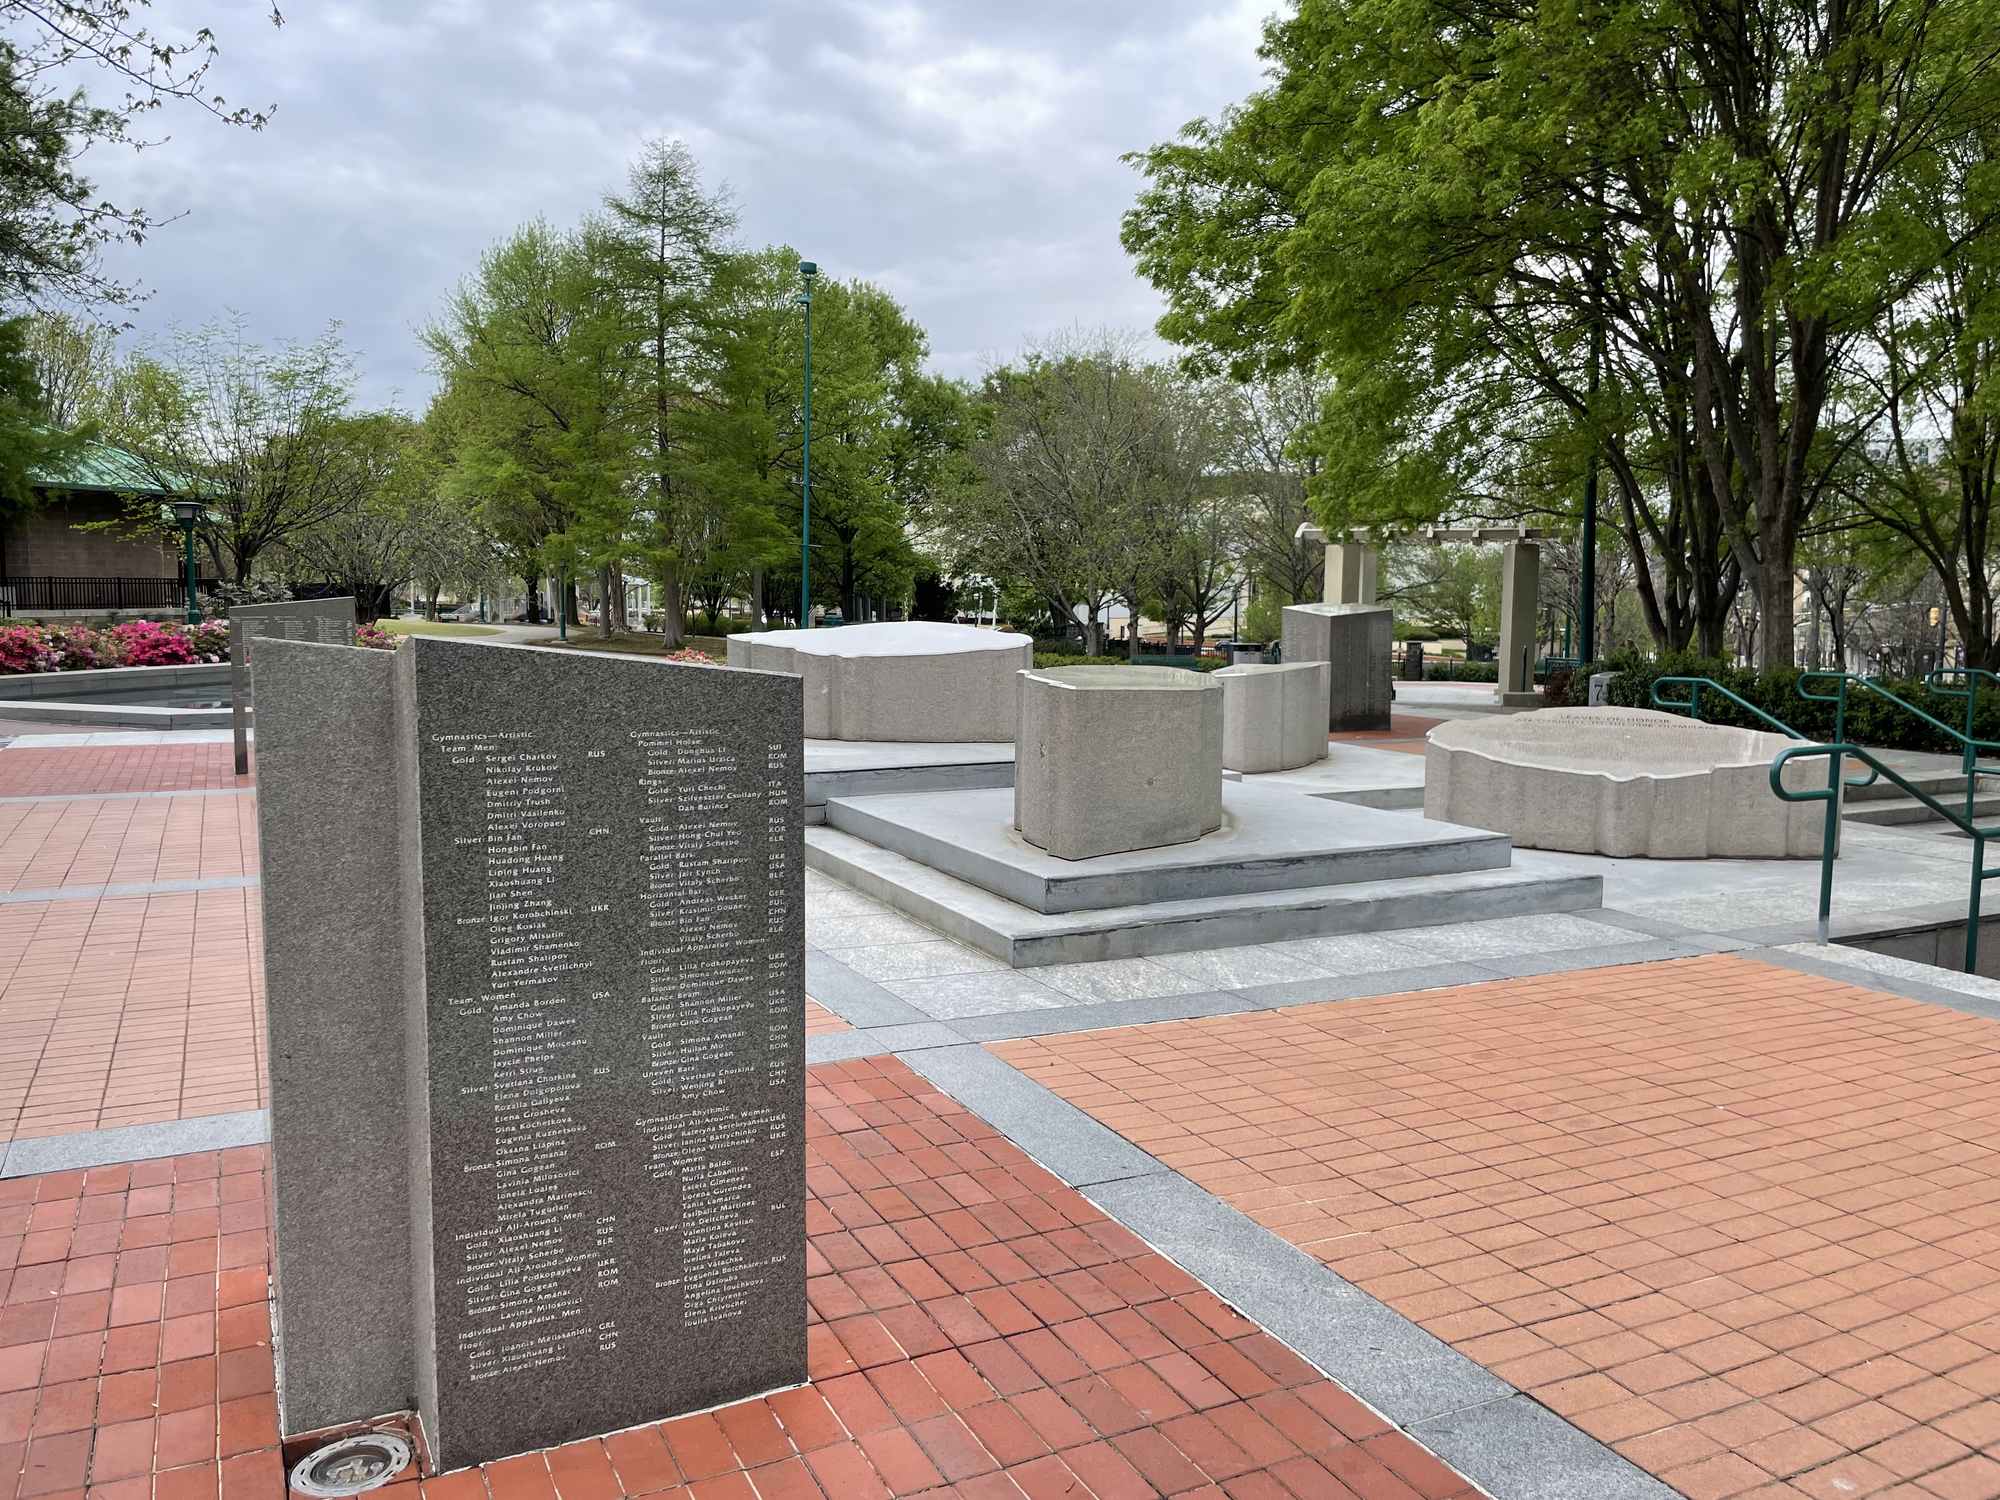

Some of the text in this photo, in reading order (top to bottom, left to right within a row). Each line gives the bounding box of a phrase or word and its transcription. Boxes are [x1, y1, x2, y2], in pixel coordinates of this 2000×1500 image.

[1594, 684, 1604, 702] 7
[486, 754, 516, 763] Sergei
[486, 765, 522, 774] Nikolay
[486, 776, 517, 785] Alexei
[526, 797, 551, 805] Trush
[769, 816, 784, 824] RUS
[487, 822, 518, 831] Alexei
[589, 827, 609, 835] CHN
[488, 845, 528, 854] Hongbin
[489, 856, 531, 865] Huadong
[488, 866, 552, 878] Liping Huang
[489, 875, 555, 888] Xiaoshuang Li
[489, 889, 533, 900] Jian Shen
[524, 899, 553, 907] Zhang
[490, 904, 610, 923] Igor UKR
[769, 916, 784, 924] RUS
[490, 925, 512, 933] Oleg
[490, 936, 526, 945] Grigory
[491, 945, 530, 955] Vladimir
[641, 945, 683, 956] Individual
[491, 958, 525, 966] Rustam
[492, 967, 538, 978] Alexandre
[492, 980, 510, 989] Yuri
[680, 970, 785, 989] Dominique Dawes USA
[493, 991, 610, 1011] Amanda Borden USA
[680, 999, 715, 1008] Shannon
[769, 988, 786, 996] USA
[493, 1011, 542, 1023] Amy Chow
[493, 1018, 576, 1033] Dominique Dawes
[493, 1031, 563, 1045] Shannon Miller
[680, 1036, 711, 1045] Simona
[769, 1033, 786, 1041] CHN
[493, 1044, 543, 1056] Dominique
[525, 1054, 554, 1063] Phelps
[494, 1069, 516, 1078] Kerri
[770, 1068, 786, 1077] CHN
[494, 1067, 611, 1090] Svetlana RUS
[703, 1088, 725, 1096] Chow
[770, 1077, 786, 1085] USA
[494, 1092, 519, 1100] Elena
[495, 1114, 520, 1123] Elena
[770, 1116, 786, 1124] UKR
[495, 1126, 516, 1134] Dina
[644, 1121, 685, 1133] Individual
[770, 1123, 785, 1131] RUS
[496, 1140, 616, 1167] Simona Amanar ROM
[771, 1150, 785, 1158] ESP
[496, 1170, 517, 1178] Gina
[497, 1178, 529, 1189] Lavinia
[498, 1198, 544, 1211] Alexandra
[771, 1202, 786, 1211] BUL
[498, 1211, 527, 1222] Mirela
[456, 1226, 502, 1241] Individual
[498, 1215, 616, 1244] Xiaoshuang Li CHN
[532, 1237, 563, 1248] Nemov
[597, 1226, 613, 1235] RUS
[498, 1237, 614, 1266] Vitaly Scherbo BLR
[684, 1246, 705, 1254] Maya
[598, 1257, 616, 1267] UKR
[771, 1255, 787, 1263] RUS
[457, 1270, 503, 1285] Individual
[500, 1267, 618, 1298] Gina Gogean ROM
[500, 1297, 533, 1309] Simona
[598, 1278, 619, 1288] ROM
[501, 1308, 533, 1320] Lavinia
[599, 1321, 616, 1330] GRE
[459, 1324, 505, 1340] Individual
[599, 1330, 618, 1340] CHN
[535, 1354, 567, 1366] Nemov
[600, 1341, 616, 1351] RUS
